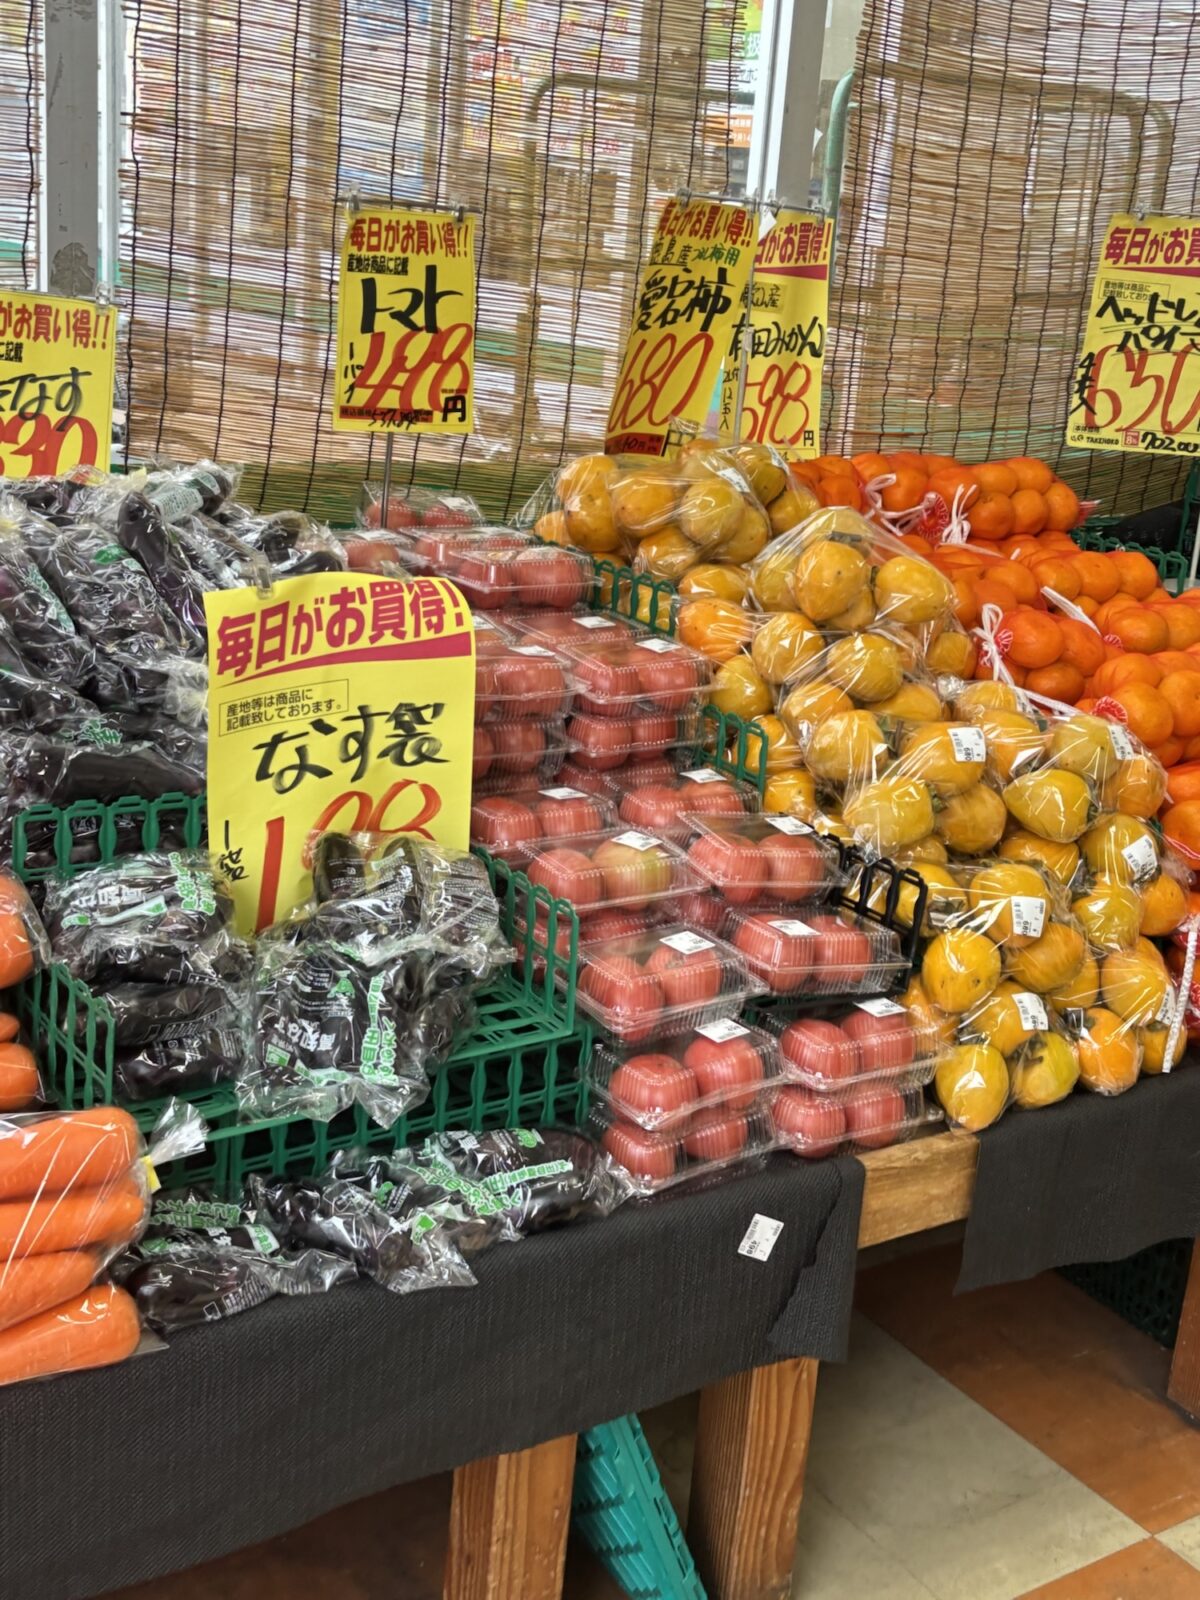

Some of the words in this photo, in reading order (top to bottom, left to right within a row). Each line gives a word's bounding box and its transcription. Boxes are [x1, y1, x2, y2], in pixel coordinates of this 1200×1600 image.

[350, 217, 469, 258] 毎日がお買い得!!
[361, 264, 463, 335] トマト
[0, 366, 93, 432] なす
[442, 395, 466, 422] 円
[608, 332, 714, 432] 680
[804, 430, 815, 446] 円
[216, 579, 464, 678] 毎日がお買得!
[226, 688, 314, 718] 産地等は商品に
[226, 698, 343, 731] 記載致しております。
[252, 702, 452, 795] なす袋
